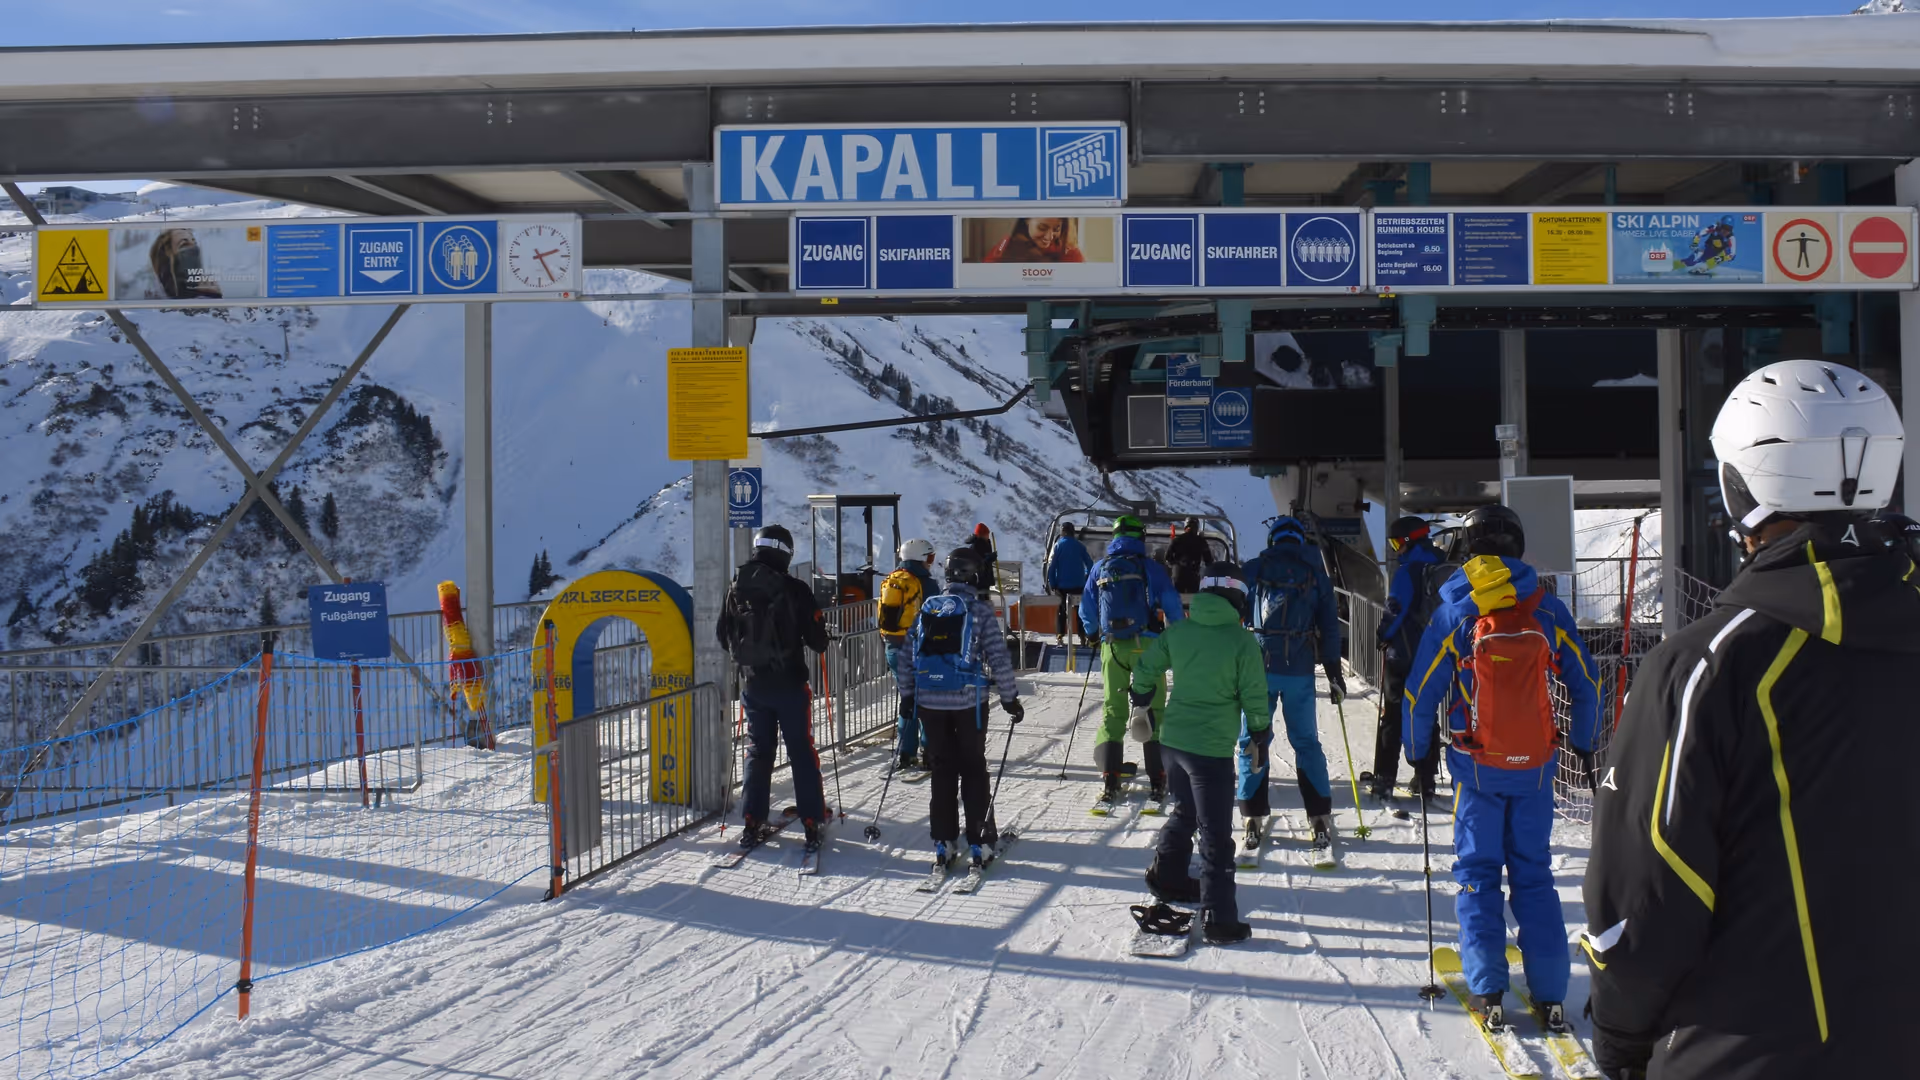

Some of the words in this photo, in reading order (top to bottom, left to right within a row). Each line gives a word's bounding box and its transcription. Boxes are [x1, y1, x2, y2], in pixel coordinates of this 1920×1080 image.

[741, 133, 1020, 201] KAPALL
[1617, 215, 1643, 228] SKI
[1648, 215, 1699, 228] ALPIN
[360, 241, 403, 253] ZUGANG
[803, 244, 863, 261] ZUGANG
[1130, 243, 1191, 260] ZUGANG
[1207, 246, 1278, 259] SKIFAHRER
[364, 256, 399, 267] ENTRY
[880, 248, 950, 262] SKIFAHRER
[1169, 379, 1211, 387] Förderband
[324, 591, 370, 603] Zugang
[558, 589, 662, 604] ARLBERGER
[320, 611, 378, 622] Fußgänger
